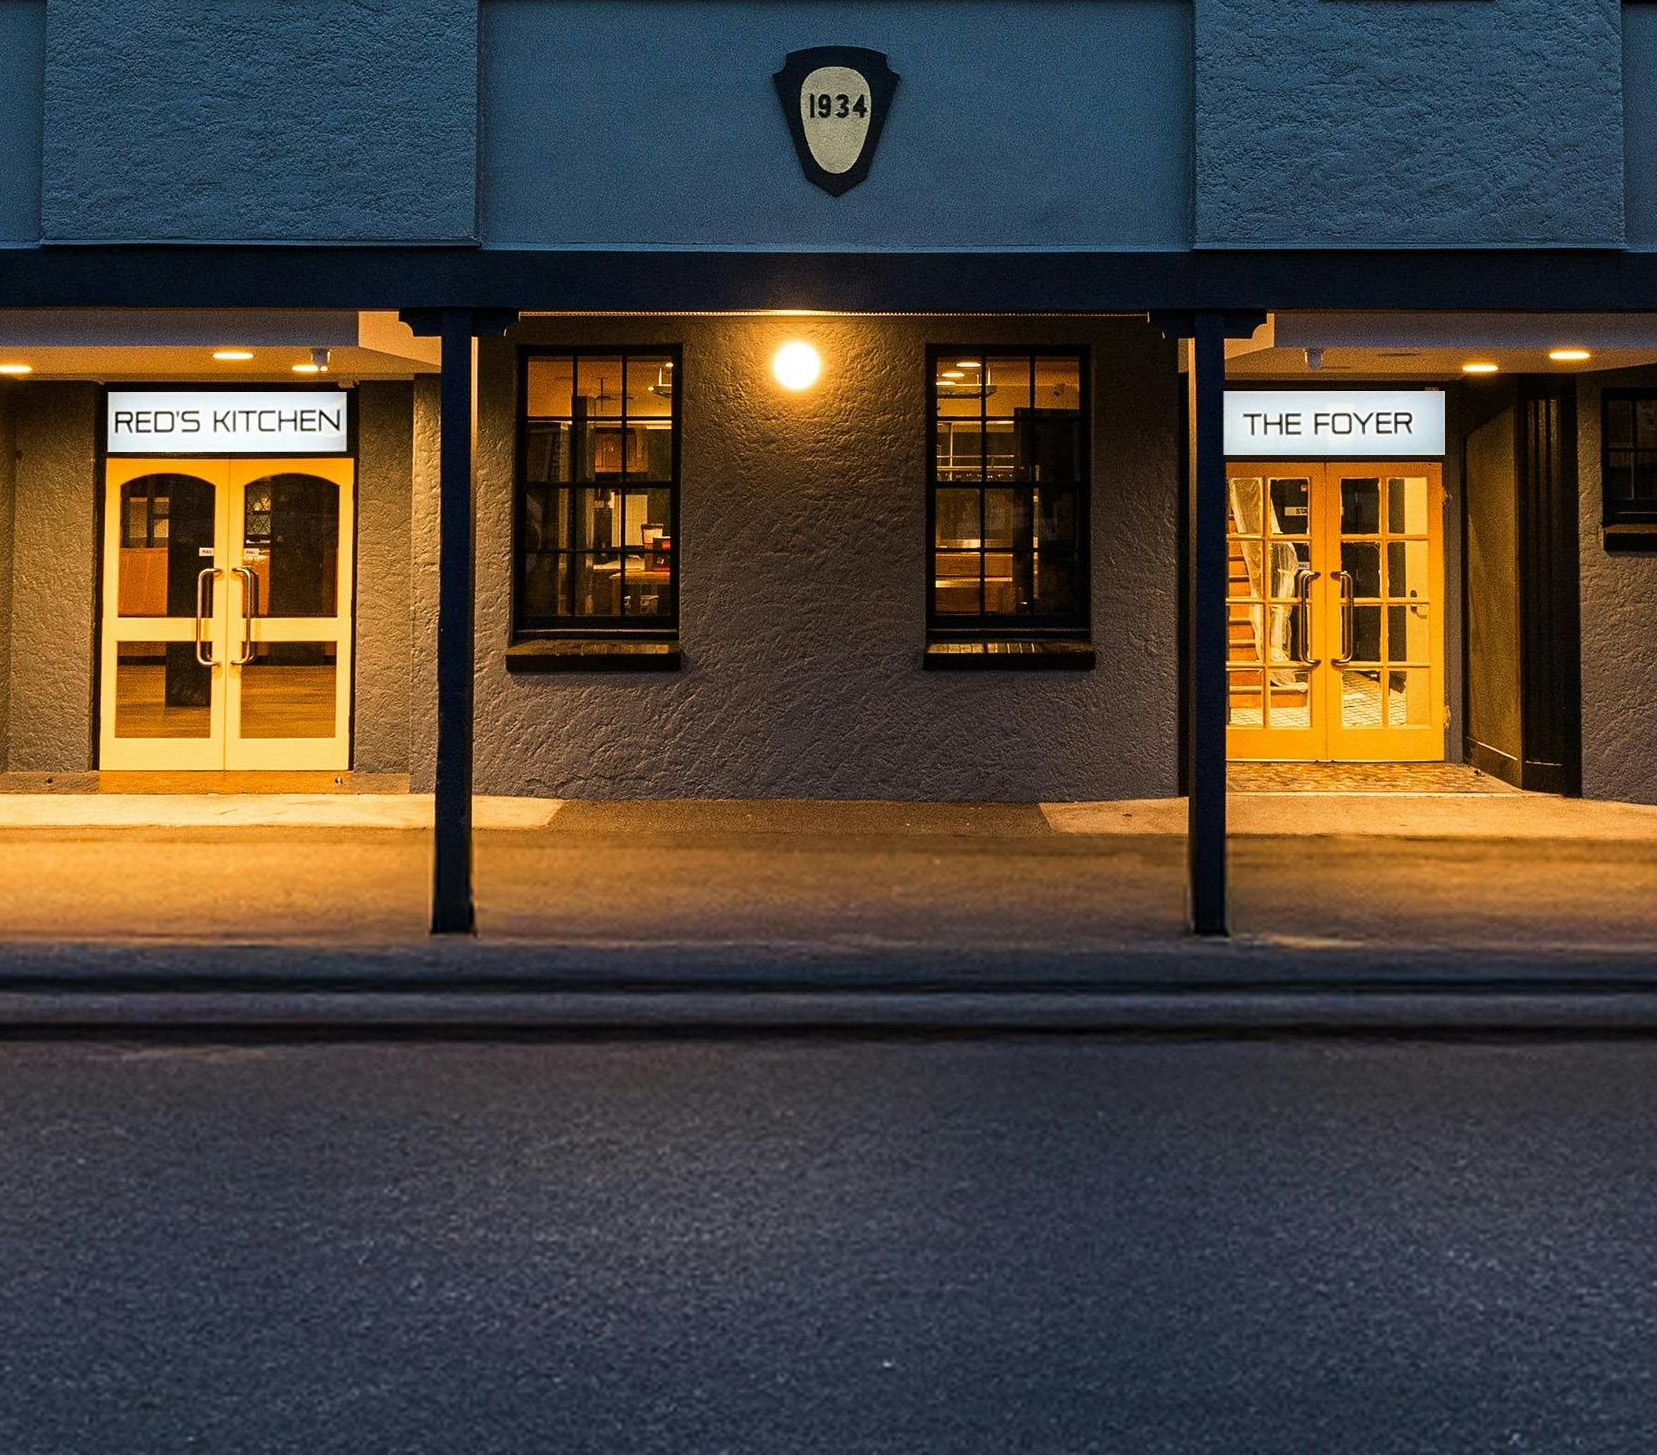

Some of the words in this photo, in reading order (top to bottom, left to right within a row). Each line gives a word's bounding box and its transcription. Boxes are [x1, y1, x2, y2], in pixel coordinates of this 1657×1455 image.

[808, 93, 868, 119] 1934
[114, 410, 201, 434] RED'S
[213, 409, 342, 433] KITCHEN
[1243, 413, 1302, 435] THE
[1314, 412, 1414, 435] FOYER
